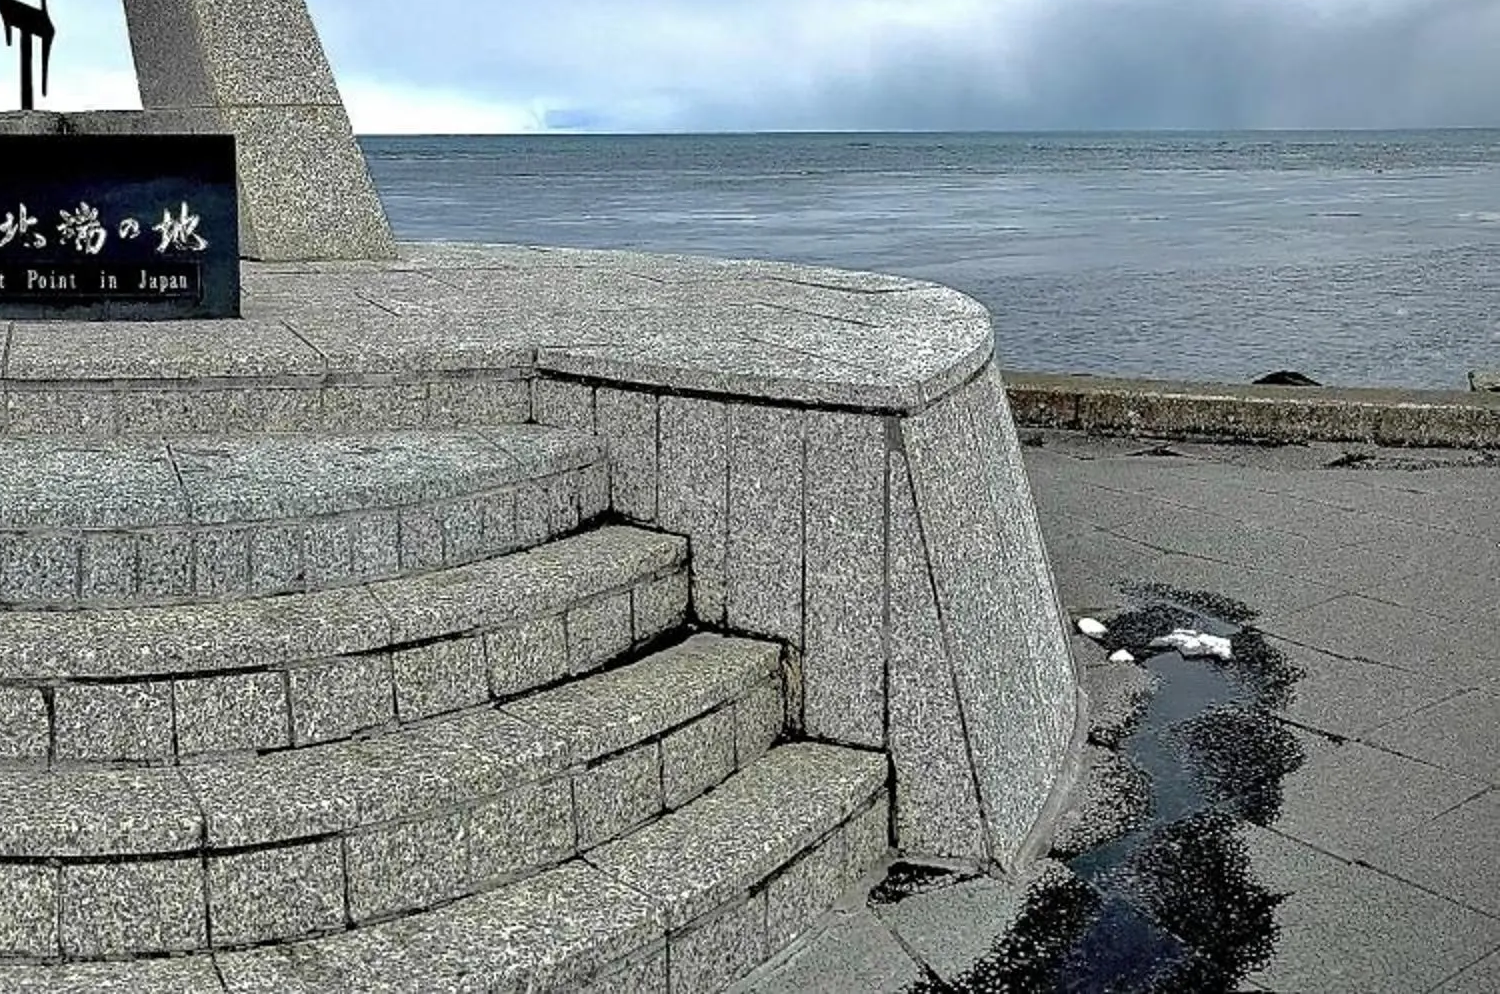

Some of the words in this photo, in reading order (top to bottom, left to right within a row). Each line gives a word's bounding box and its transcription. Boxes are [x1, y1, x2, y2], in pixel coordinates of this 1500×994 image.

[26, 269, 77, 289] Point
[99, 270, 118, 289] in
[138, 269, 188, 292] Japan
